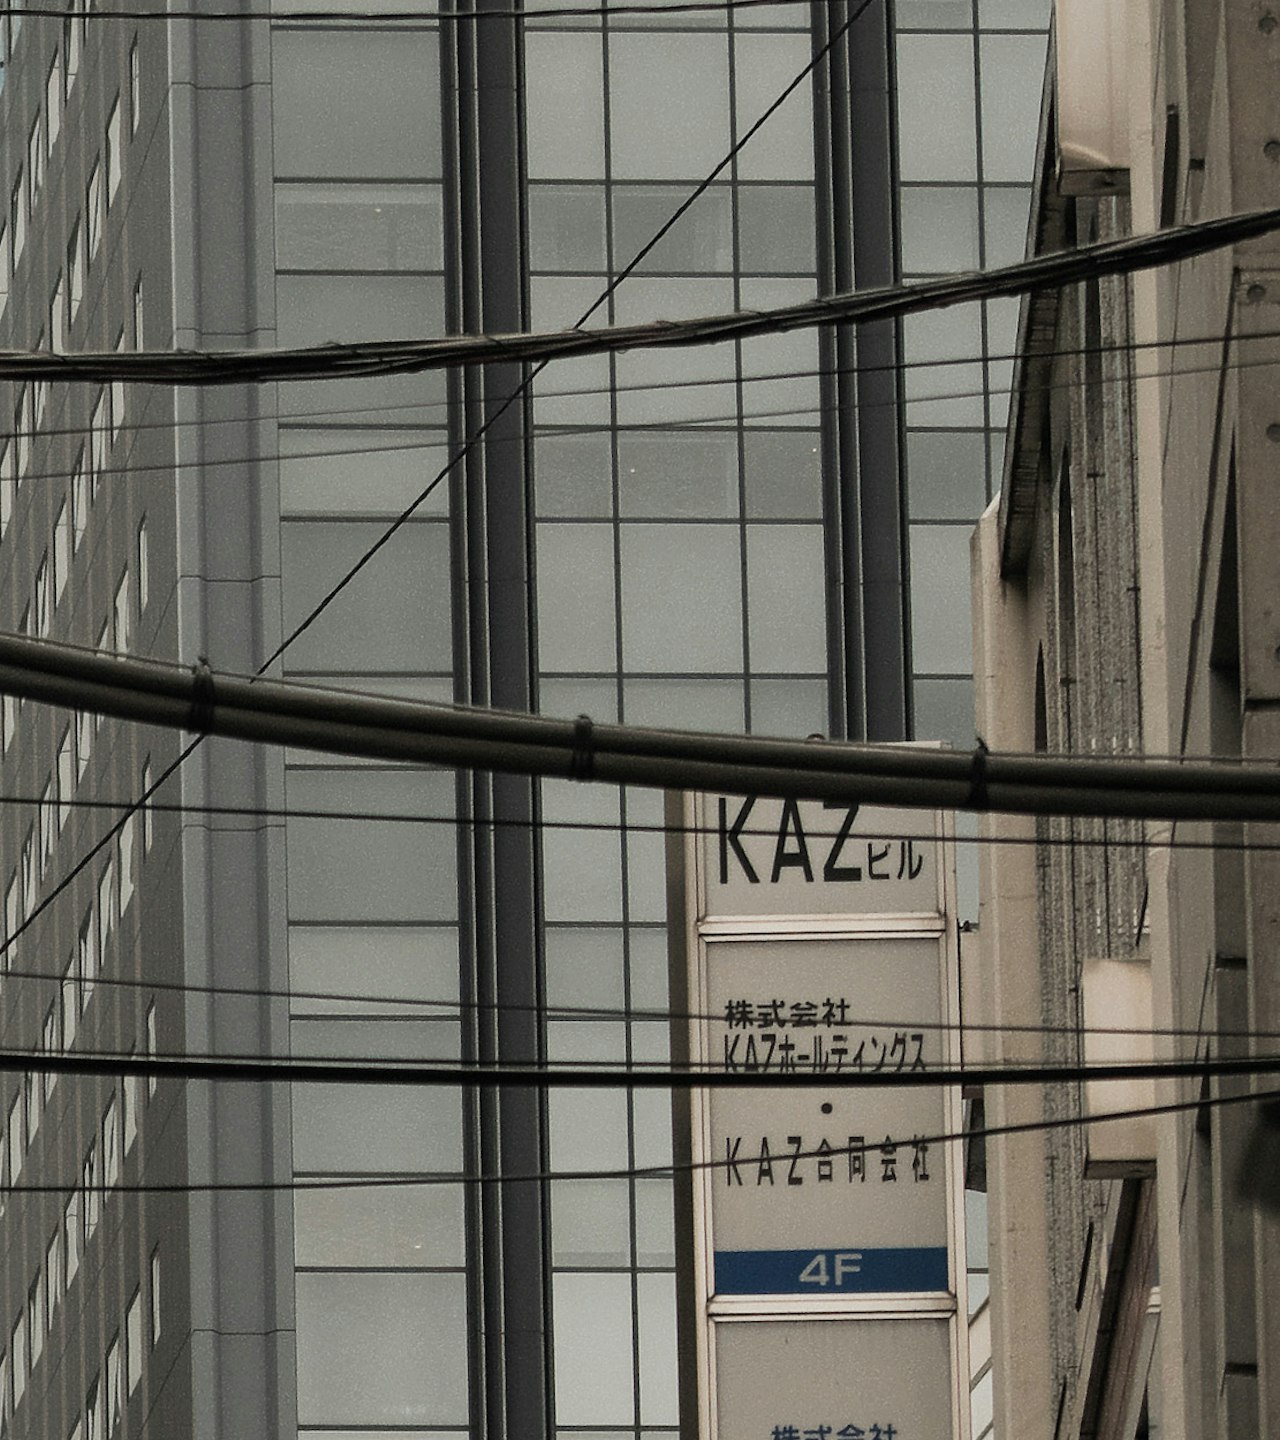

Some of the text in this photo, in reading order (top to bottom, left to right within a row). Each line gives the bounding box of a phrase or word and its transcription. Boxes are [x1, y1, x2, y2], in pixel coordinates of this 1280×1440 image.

[724, 997, 852, 1030] 株式会社
[726, 1134, 930, 1187] KAZ合同会社
[799, 1253, 863, 1287] 4F
